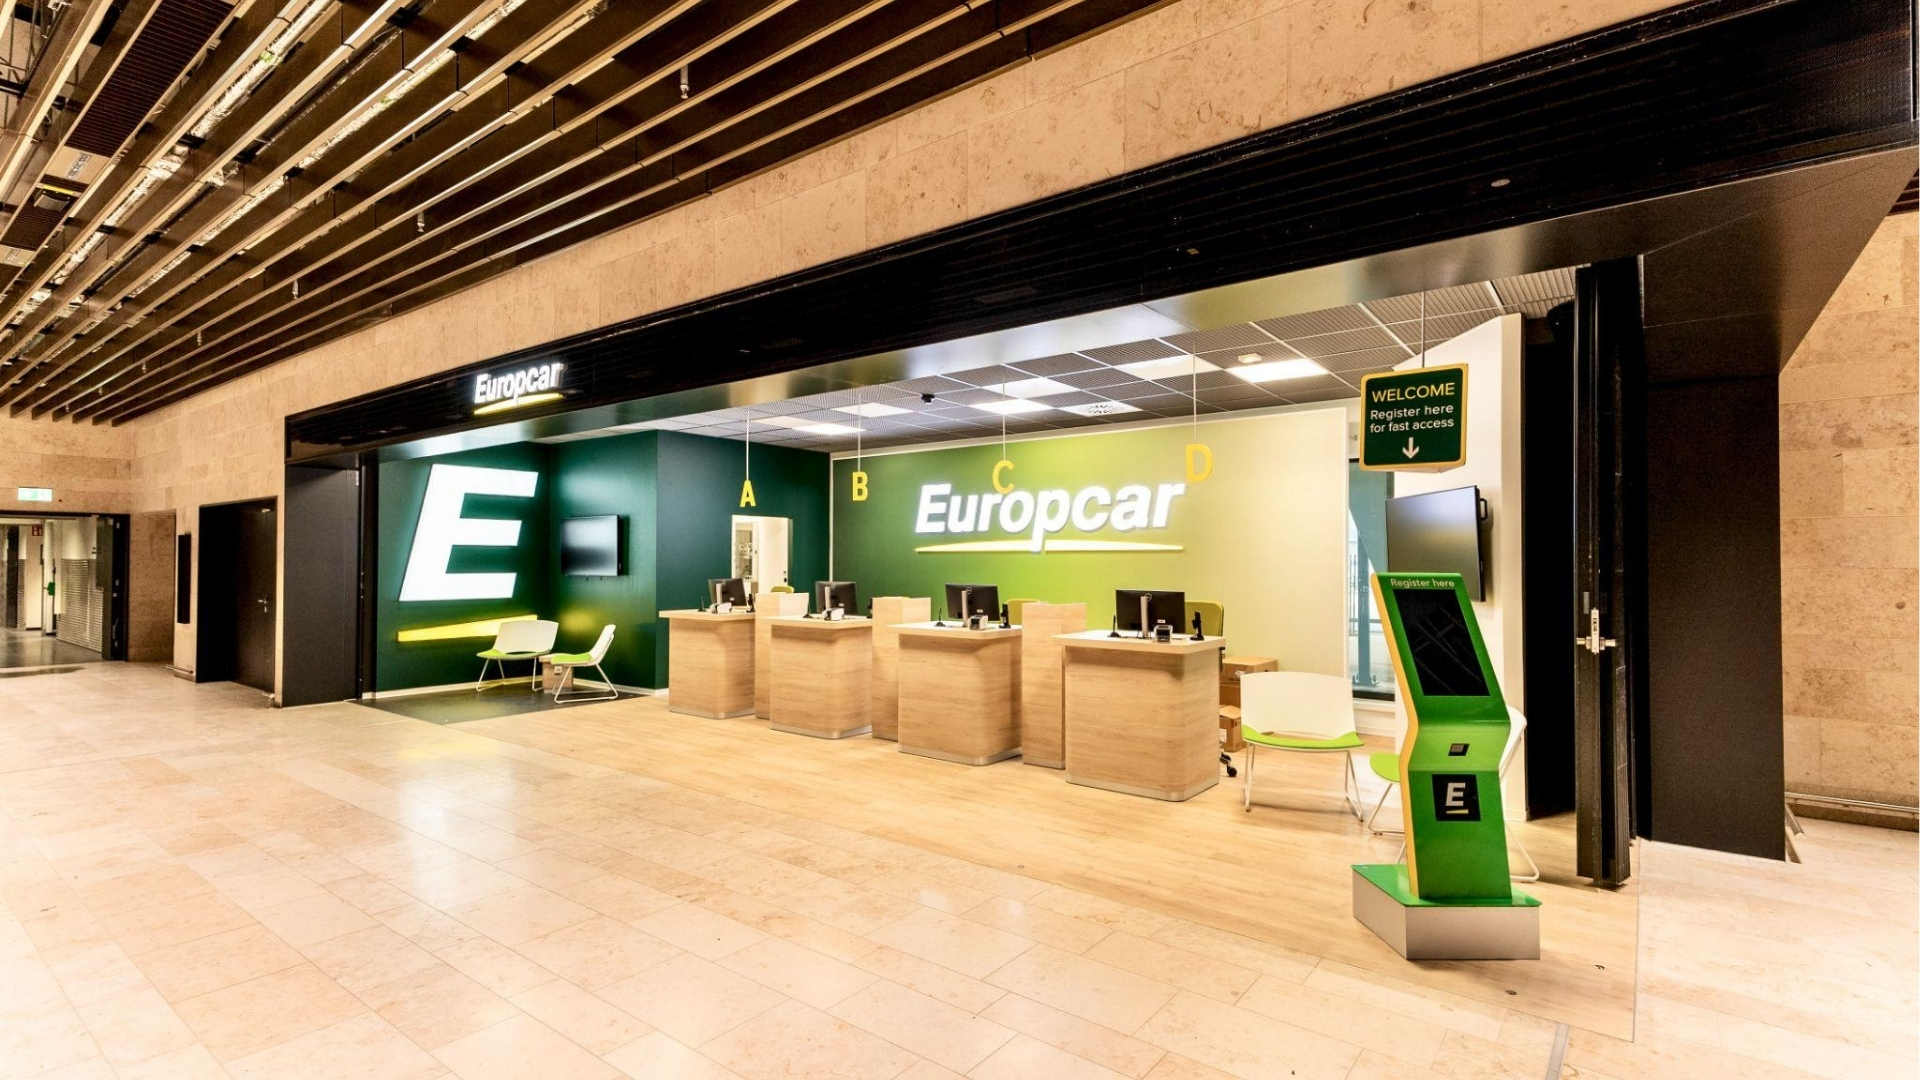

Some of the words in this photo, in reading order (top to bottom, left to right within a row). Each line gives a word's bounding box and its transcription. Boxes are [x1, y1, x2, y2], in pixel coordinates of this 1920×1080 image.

[475, 362, 566, 404] Europcar
[1372, 382, 1455, 403] WELCOME
[1370, 407, 1421, 421] Register
[1424, 404, 1454, 415] here
[1370, 422, 1386, 433] for
[1388, 421, 1410, 432] fast
[1412, 418, 1454, 430] access
[992, 459, 1015, 494] C
[1186, 444, 1213, 483] D
[739, 480, 757, 508] A
[852, 471, 869, 502] B
[915, 482, 1186, 553] Europcar
[399, 463, 539, 602] E
[1390, 578, 1430, 589] Register
[1431, 578, 1455, 587] here
[1445, 782, 1466, 807] E
